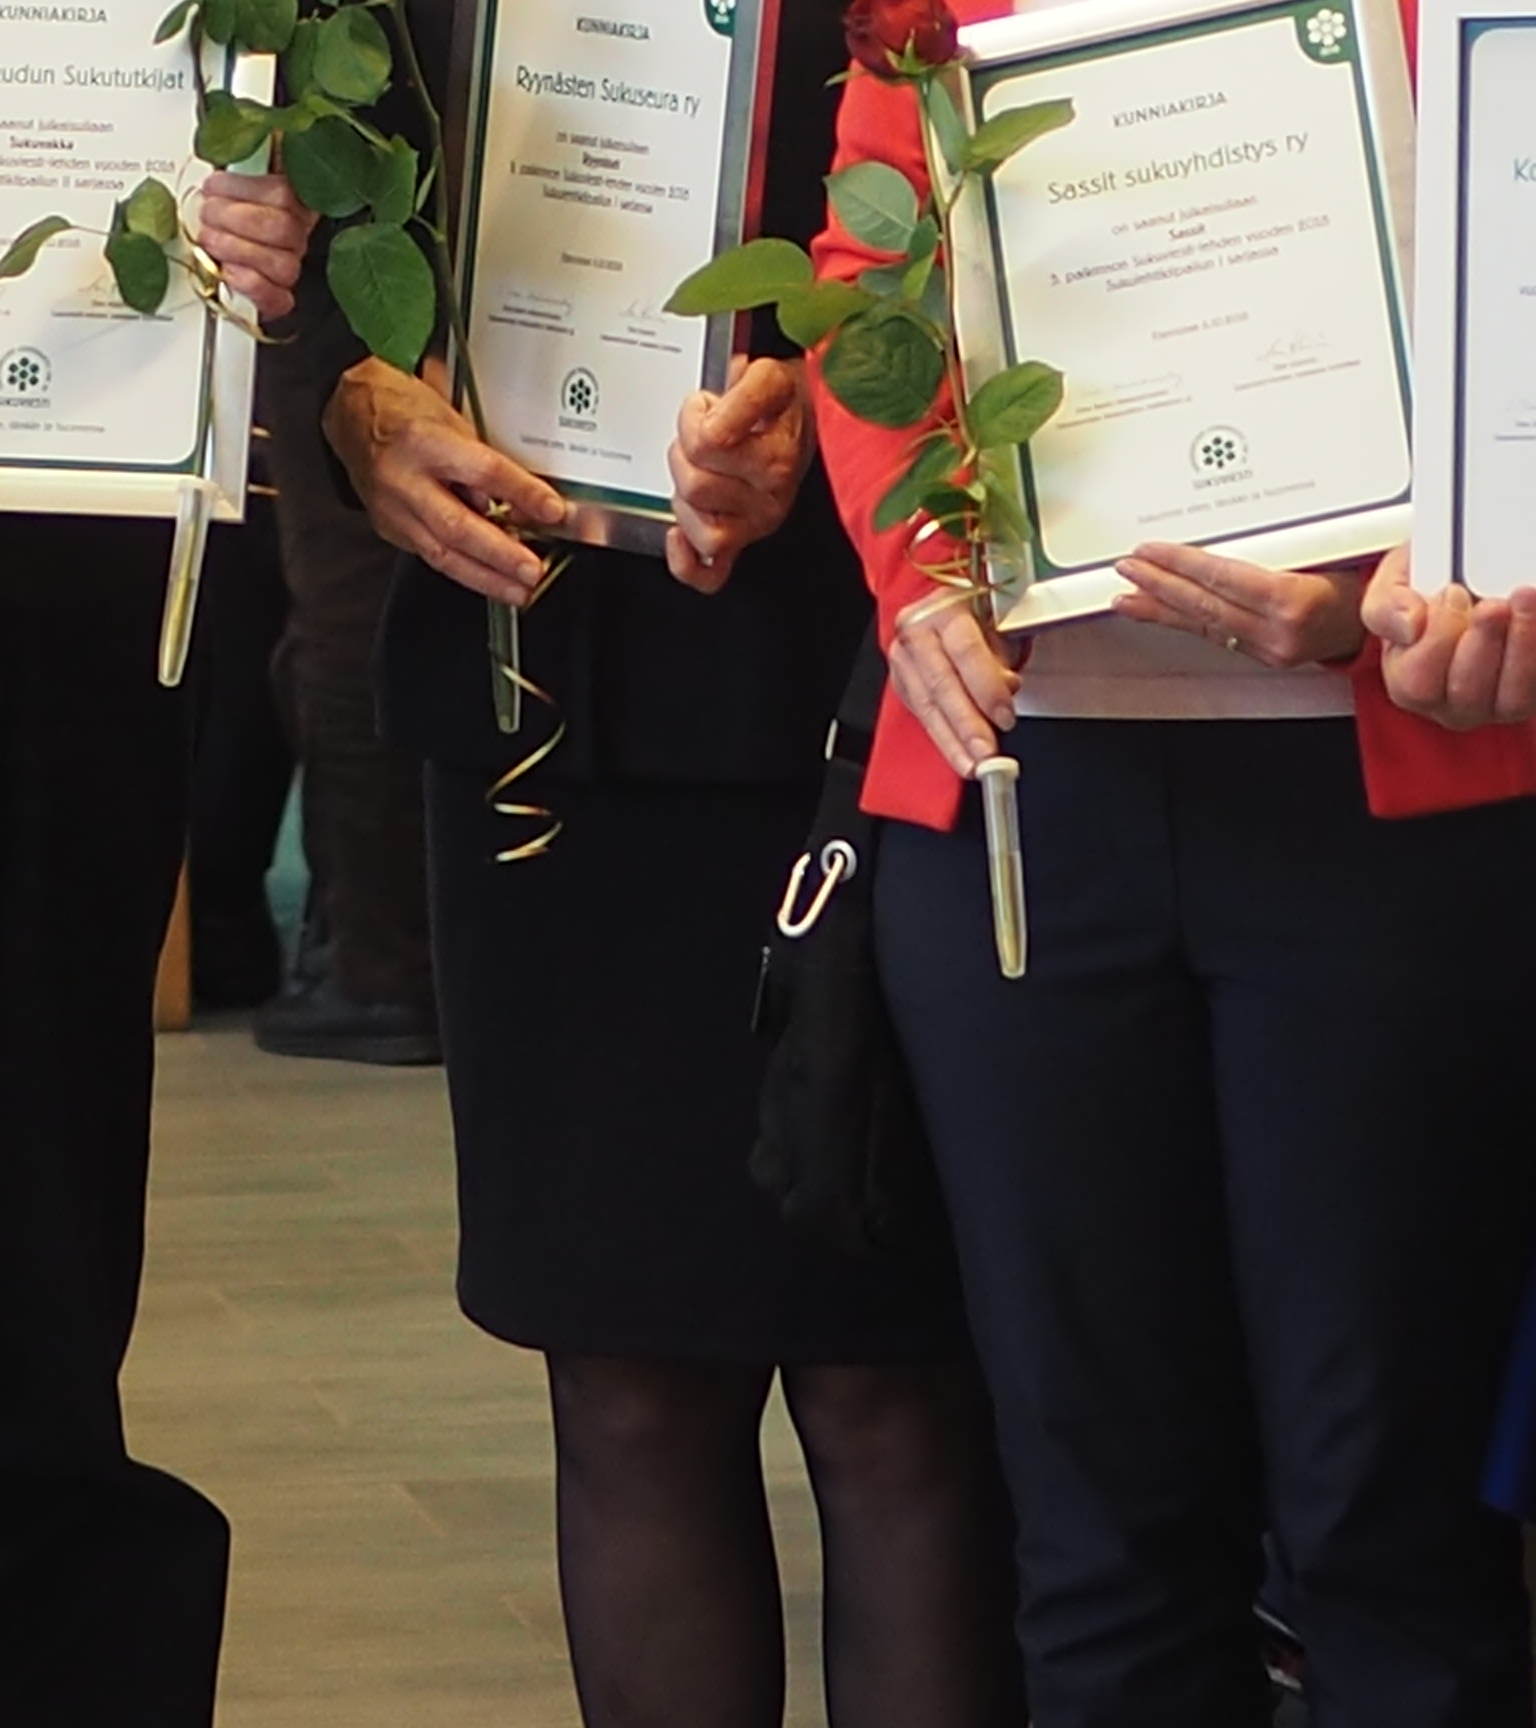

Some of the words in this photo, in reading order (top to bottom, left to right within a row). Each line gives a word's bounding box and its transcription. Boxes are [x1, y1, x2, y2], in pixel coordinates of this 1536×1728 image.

[62, 65, 185, 92] Sukututkijat
[516, 64, 596, 101] Ryynästen
[600, 76, 679, 113] Sukuseura
[683, 94, 701, 119] ry
[1112, 90, 1228, 128] KUNNIAKIRJA
[1047, 170, 1117, 205] Sassit
[1124, 137, 1279, 189] sukuyhdistys
[1285, 132, 1309, 155] ry
